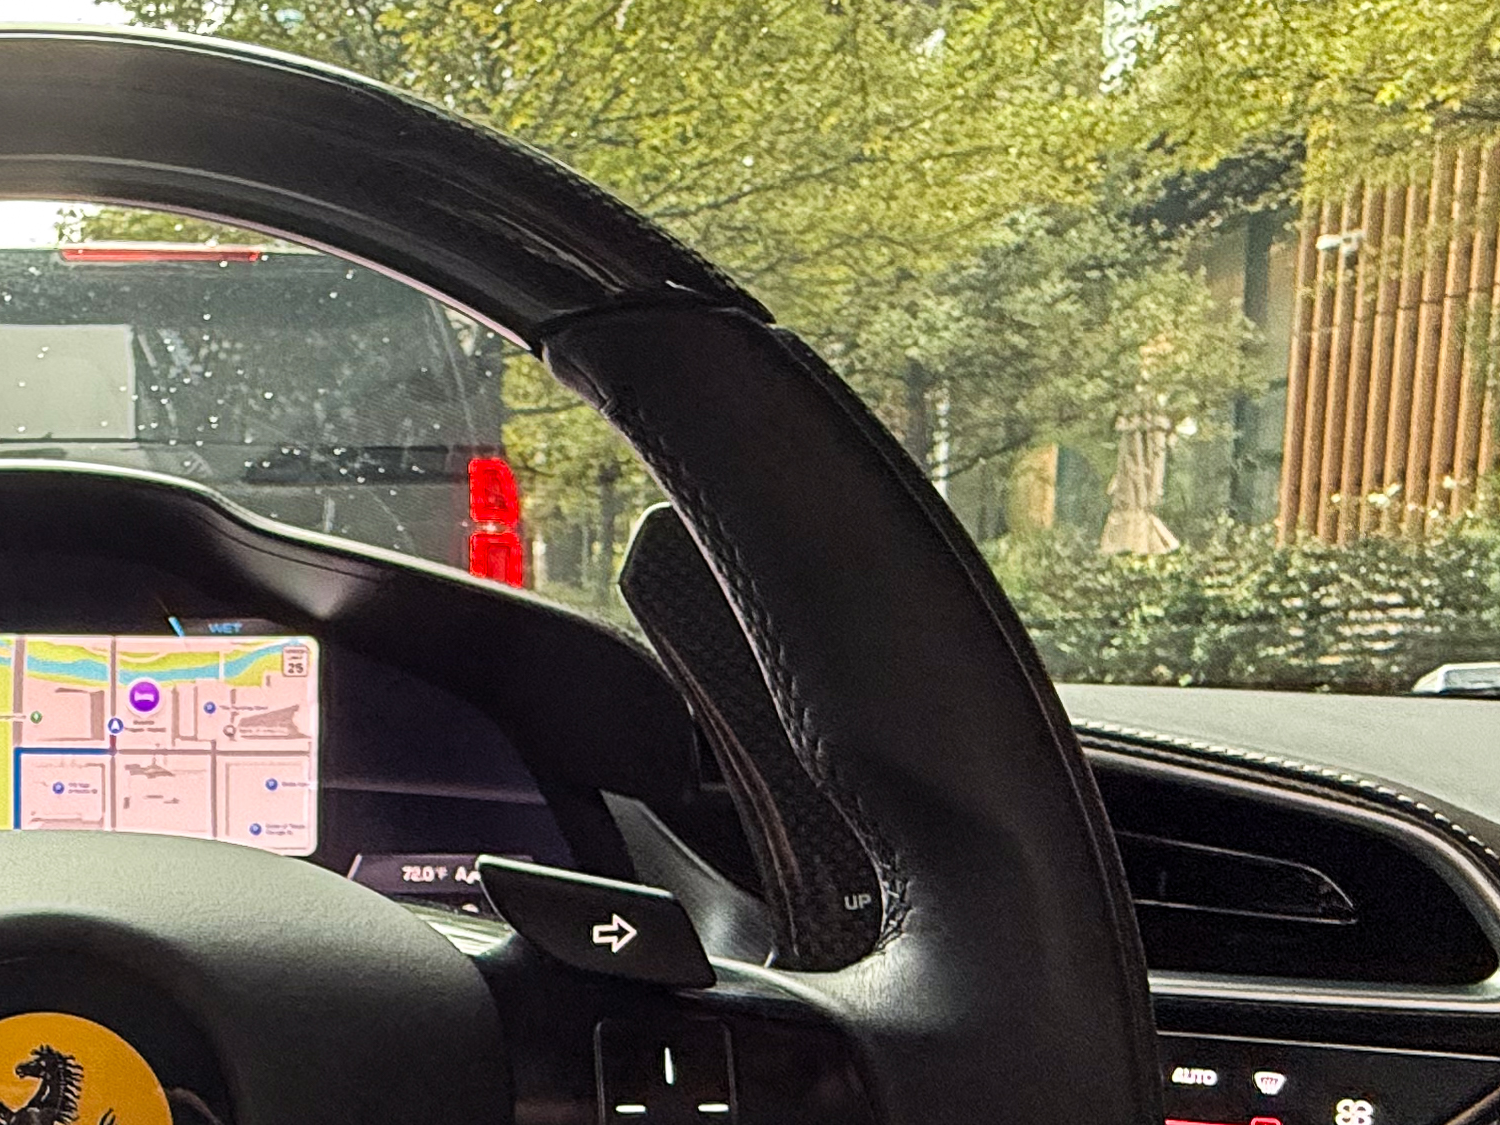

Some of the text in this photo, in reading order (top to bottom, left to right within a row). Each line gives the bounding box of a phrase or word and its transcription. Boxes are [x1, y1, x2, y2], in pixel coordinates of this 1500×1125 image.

[208, 622, 242, 633] WET
[844, 893, 872, 911] UP
[1171, 1066, 1217, 1086] AUTO
